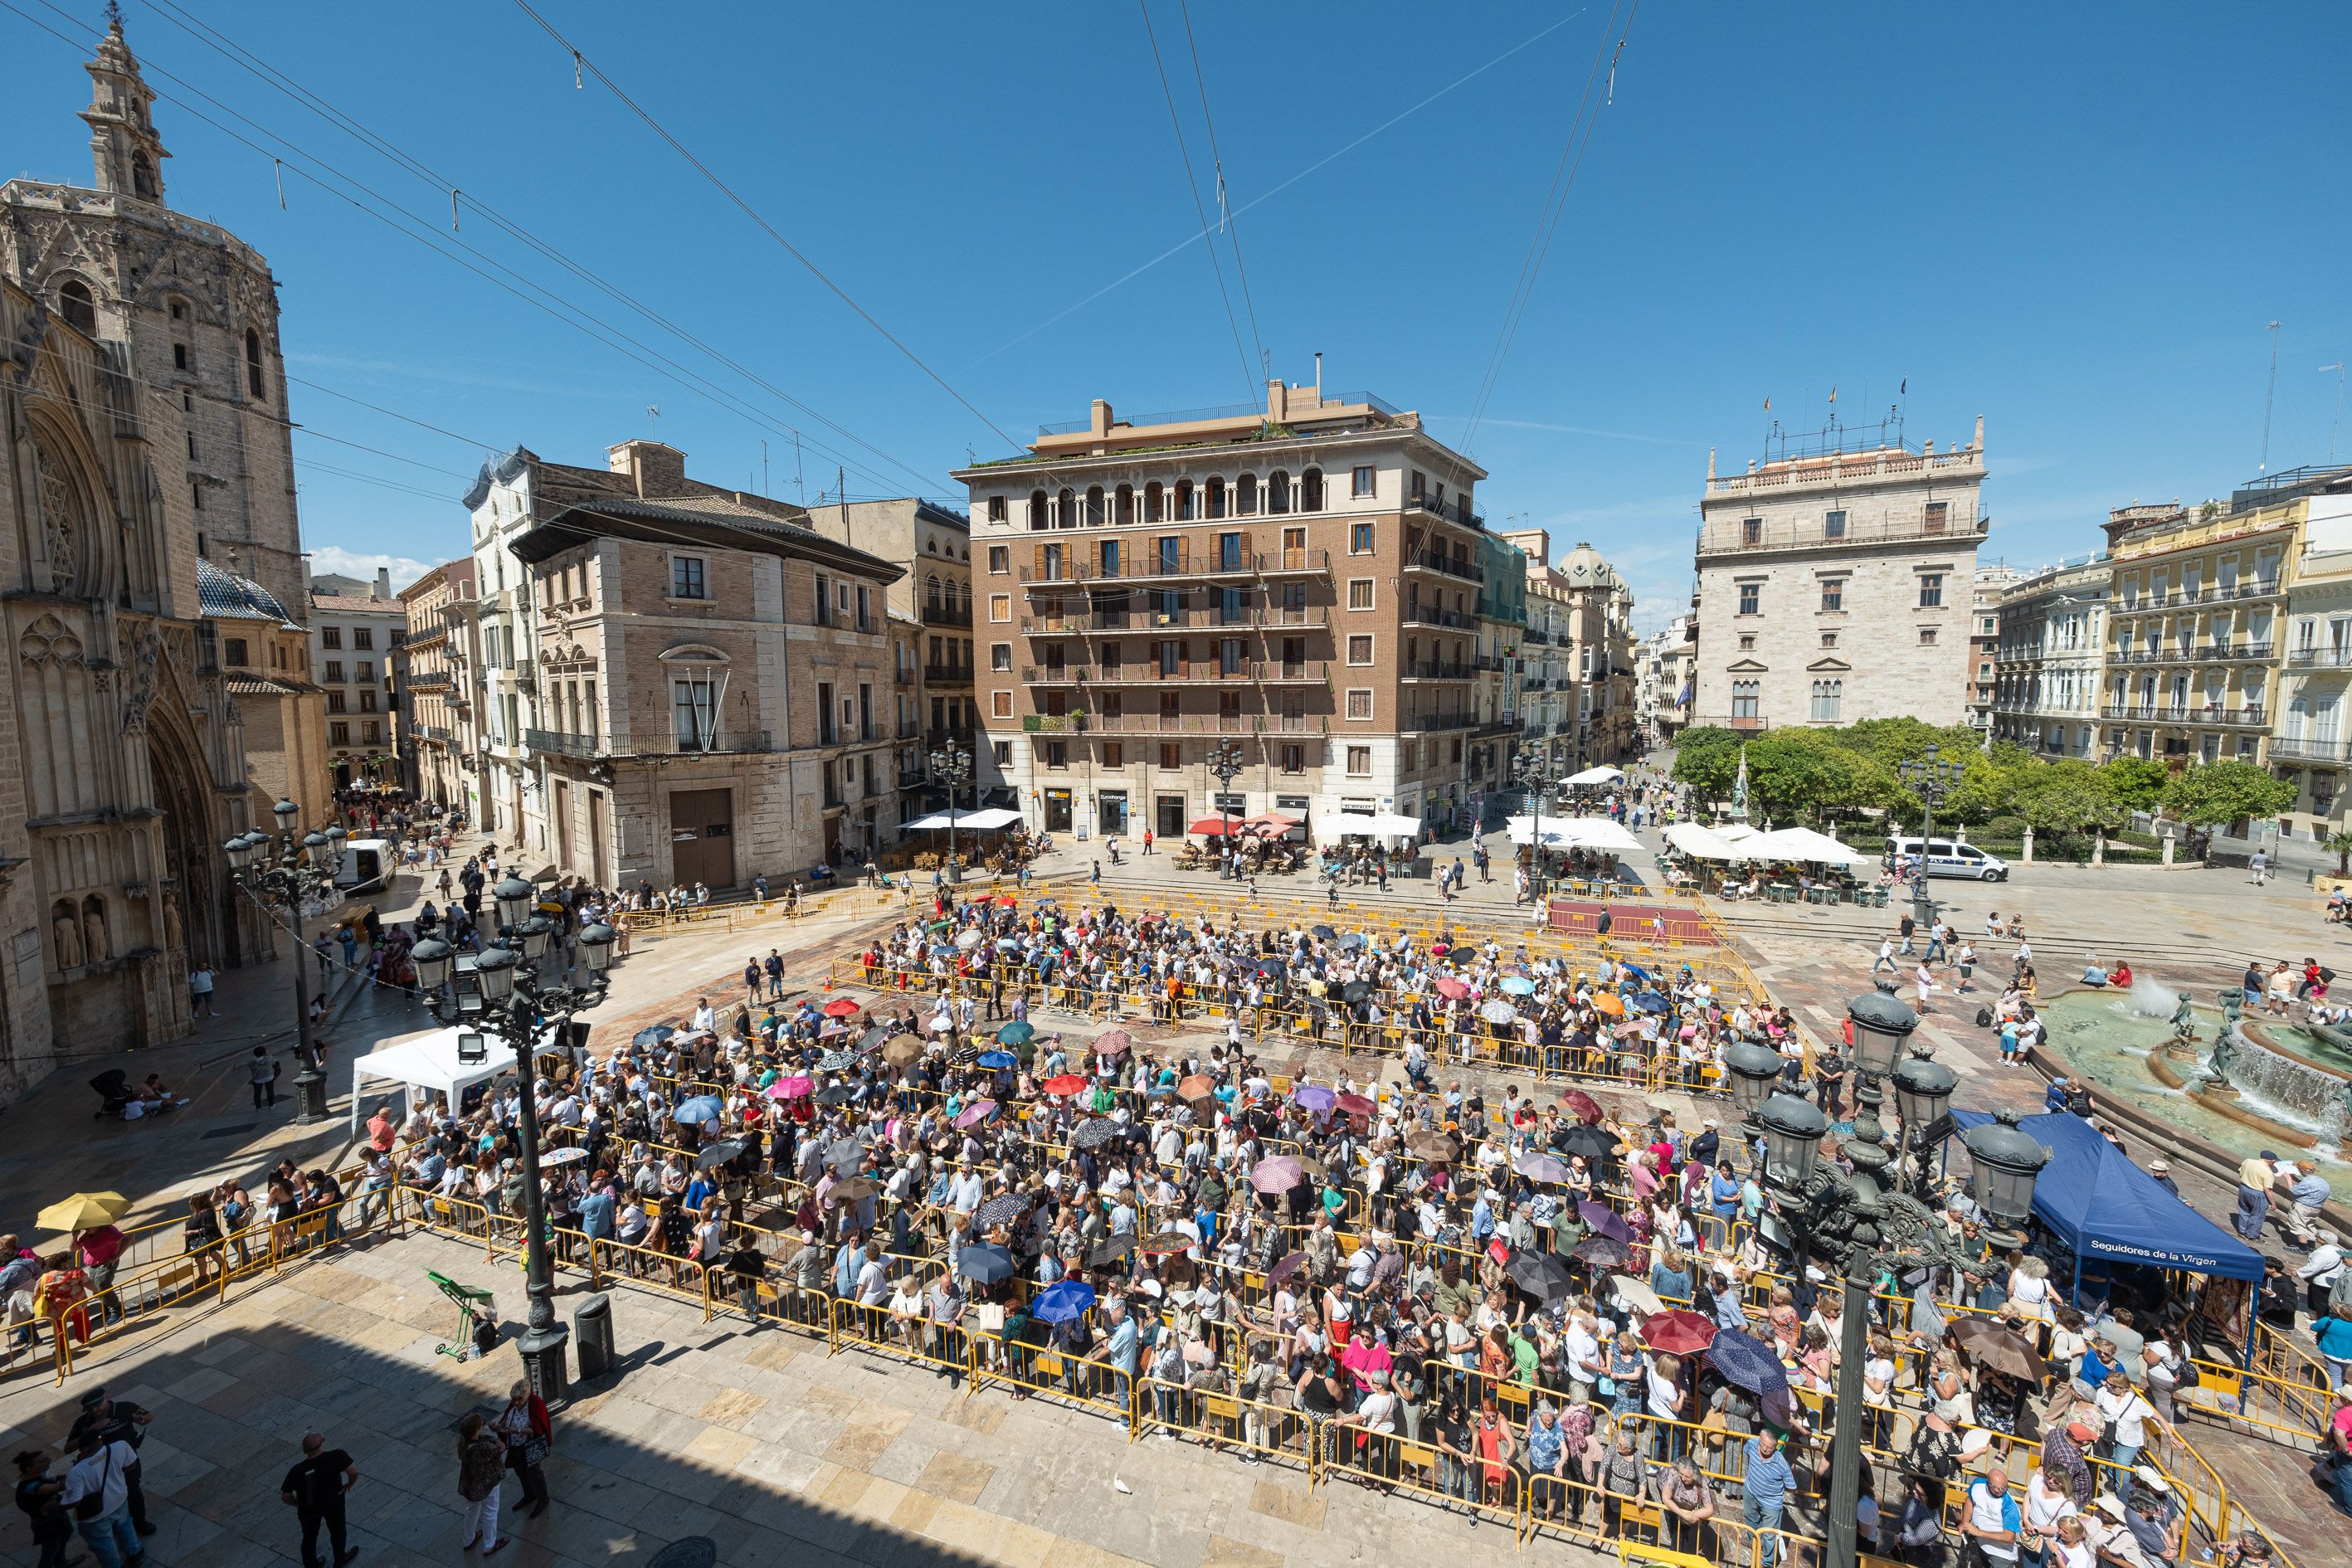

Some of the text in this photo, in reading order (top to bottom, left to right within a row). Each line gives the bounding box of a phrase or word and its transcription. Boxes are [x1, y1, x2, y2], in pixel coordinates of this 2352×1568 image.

[2091, 1240, 2217, 1266] Seguidores de la Virgen
